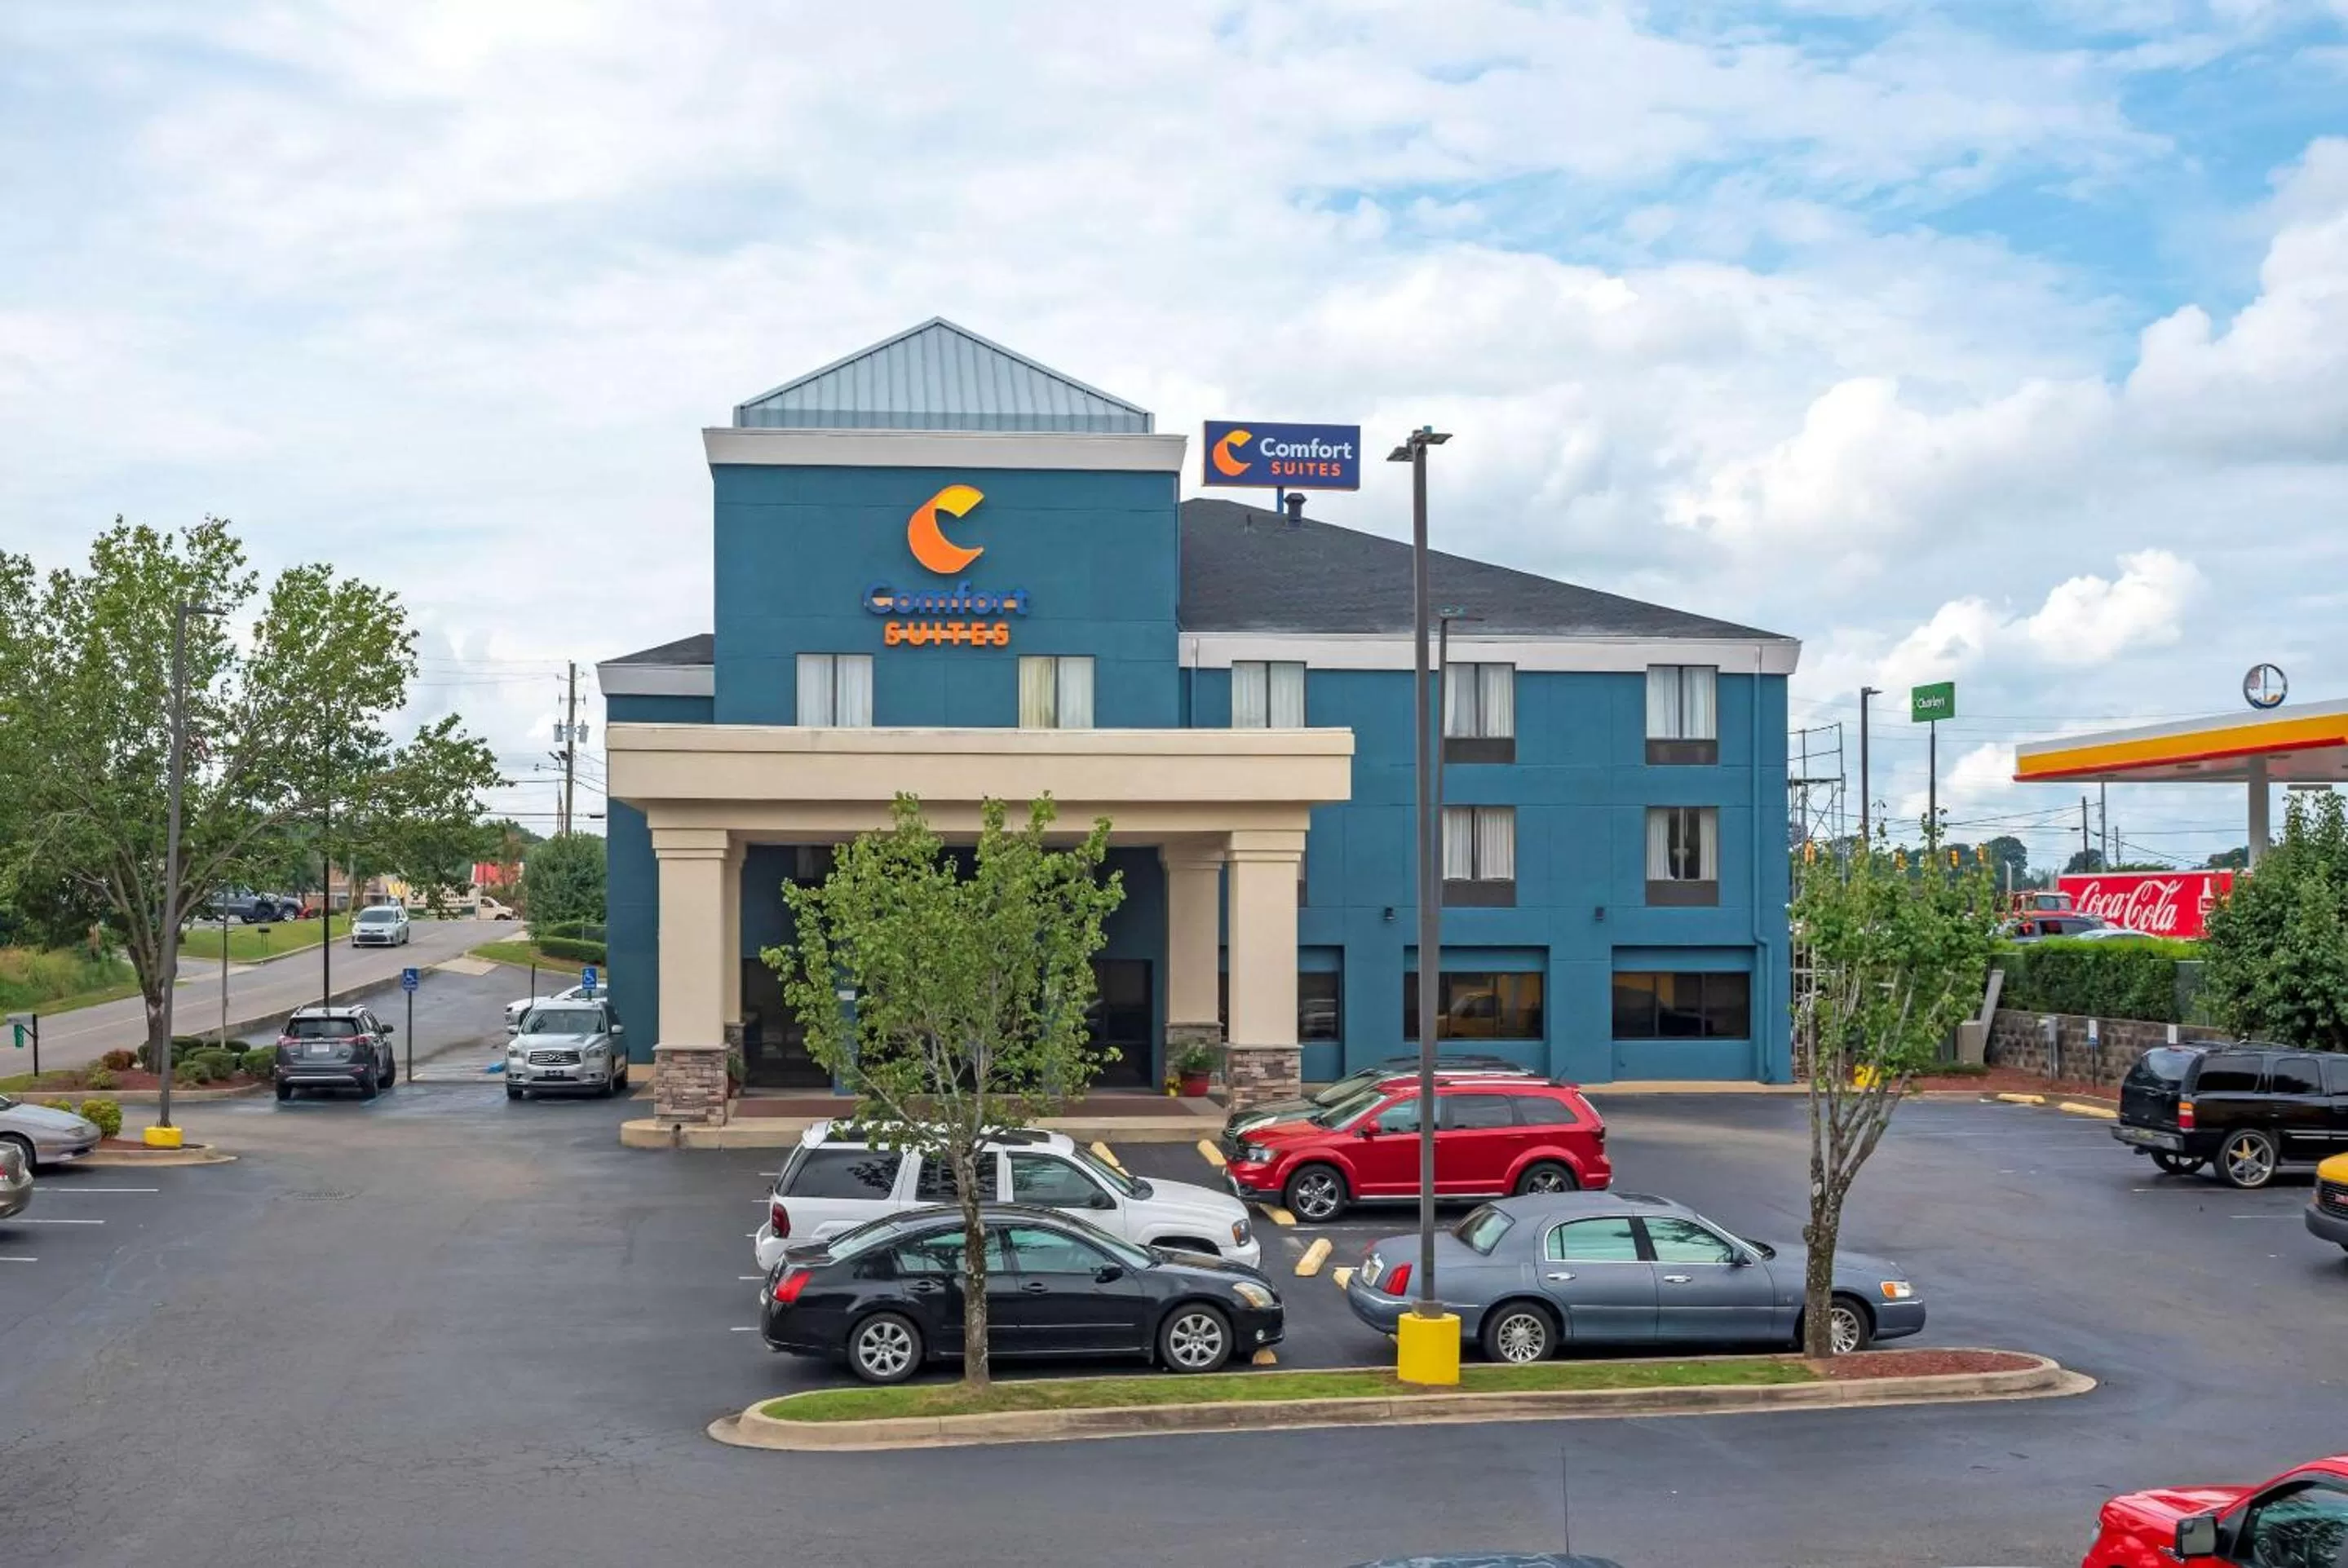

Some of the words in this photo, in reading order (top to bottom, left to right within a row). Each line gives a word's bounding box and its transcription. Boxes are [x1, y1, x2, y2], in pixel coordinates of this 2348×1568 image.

[1259, 437, 1353, 460] Comfort
[1271, 461, 1342, 477] SUITES
[863, 580, 1031, 616] Comfort
[884, 621, 1010, 646] SUITES
[2076, 879, 2184, 931] Coca-Cola
